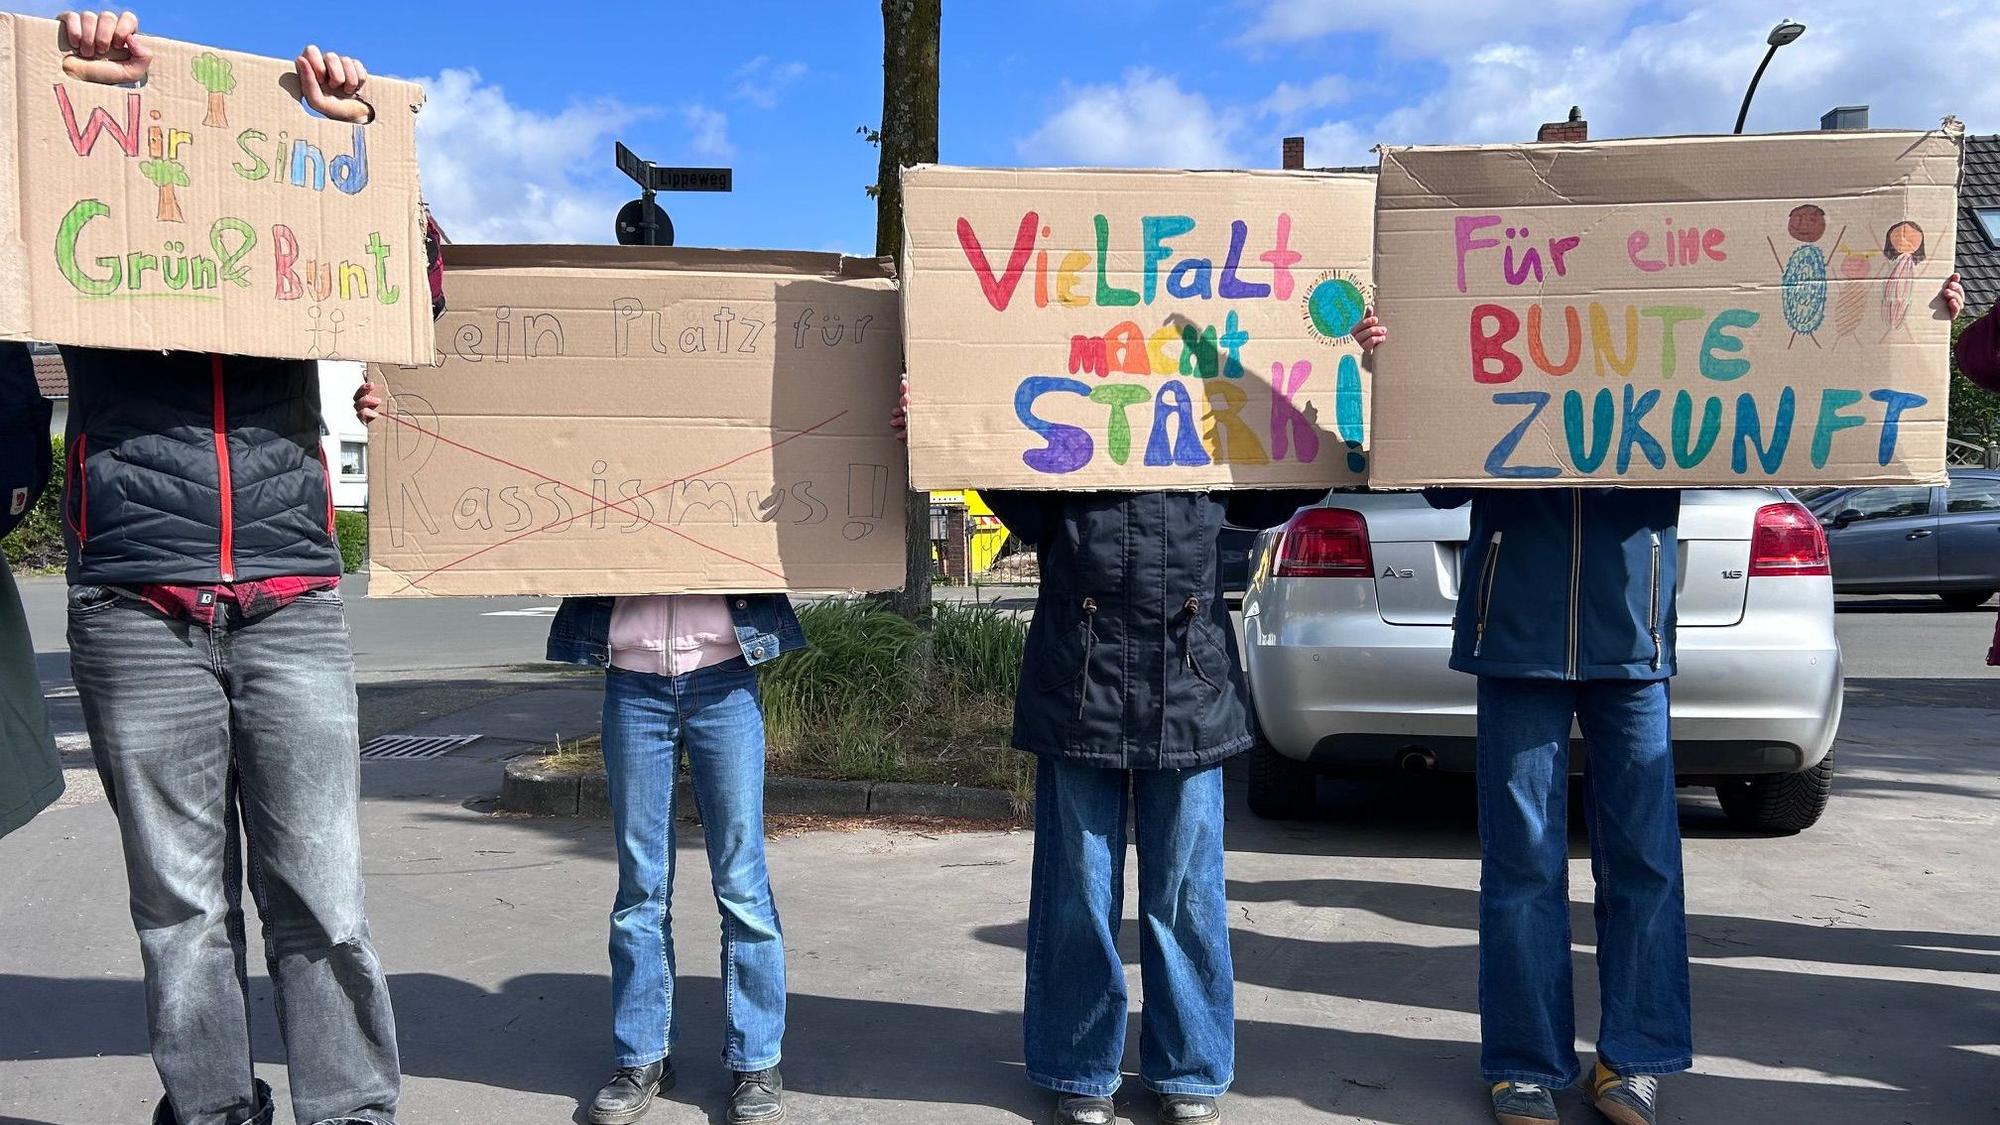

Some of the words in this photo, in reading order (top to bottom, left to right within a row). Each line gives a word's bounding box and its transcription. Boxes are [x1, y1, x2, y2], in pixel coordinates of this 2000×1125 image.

[53, 83, 194, 157] Wir
[659, 171, 727, 190] Lippeweg
[272, 223, 400, 304] Bunt
[1453, 214, 1580, 293] Für
[612, 296, 766, 360] Platz
[793, 306, 874, 350] für
[1469, 302, 1761, 385] BUNTE
[1483, 383, 1928, 479] ZUKUNFT
[1380, 564, 1415, 579] A3
